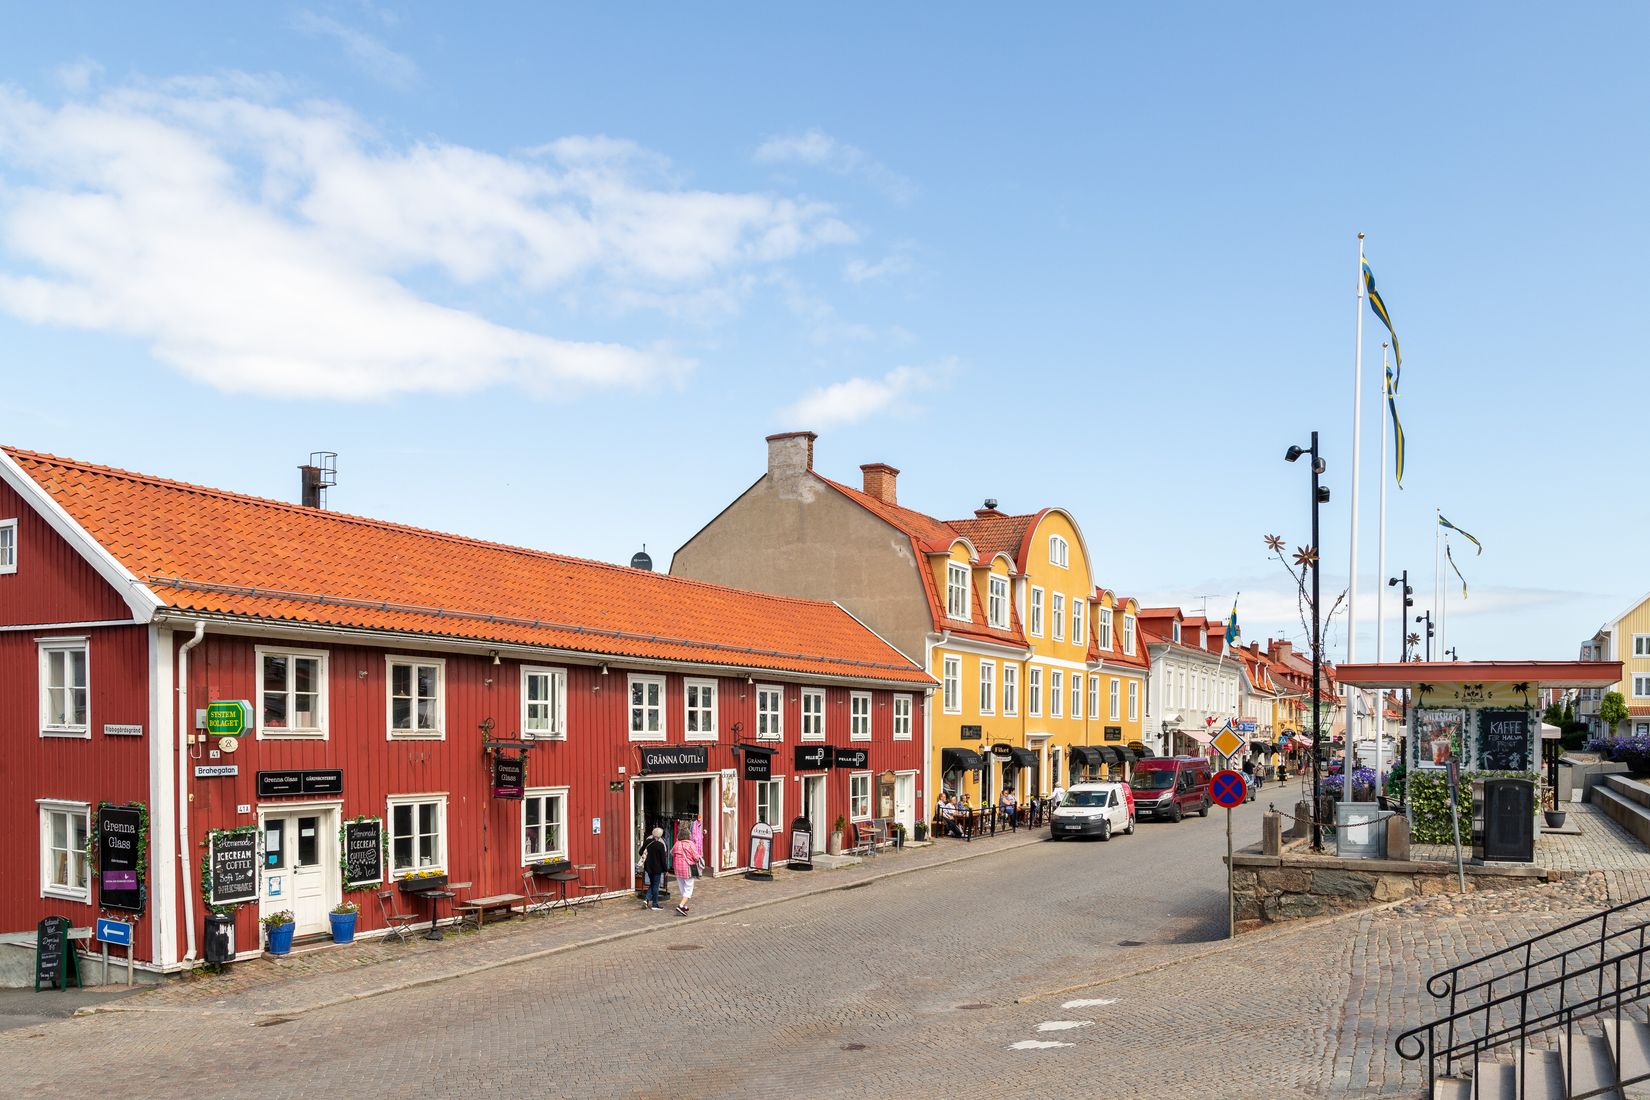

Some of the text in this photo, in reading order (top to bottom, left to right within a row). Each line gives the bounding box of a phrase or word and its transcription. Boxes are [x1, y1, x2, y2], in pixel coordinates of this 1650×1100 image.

[1490, 720, 1522, 734] KAFFE
[647, 754, 678, 765] GRÄNNA
[747, 757, 768, 765] GRÄNNA
[197, 767, 236, 776] Brahegatan
[498, 764, 520, 773] Grenna
[501, 773, 517, 782] Glass
[103, 819, 136, 834] Grenna
[108, 836, 131, 850] Glass
[350, 839, 377, 850] ICECREAM
[217, 850, 252, 862] ICECREAM
[225, 859, 252, 871] COFFEE
[219, 872, 234, 884] Soft
